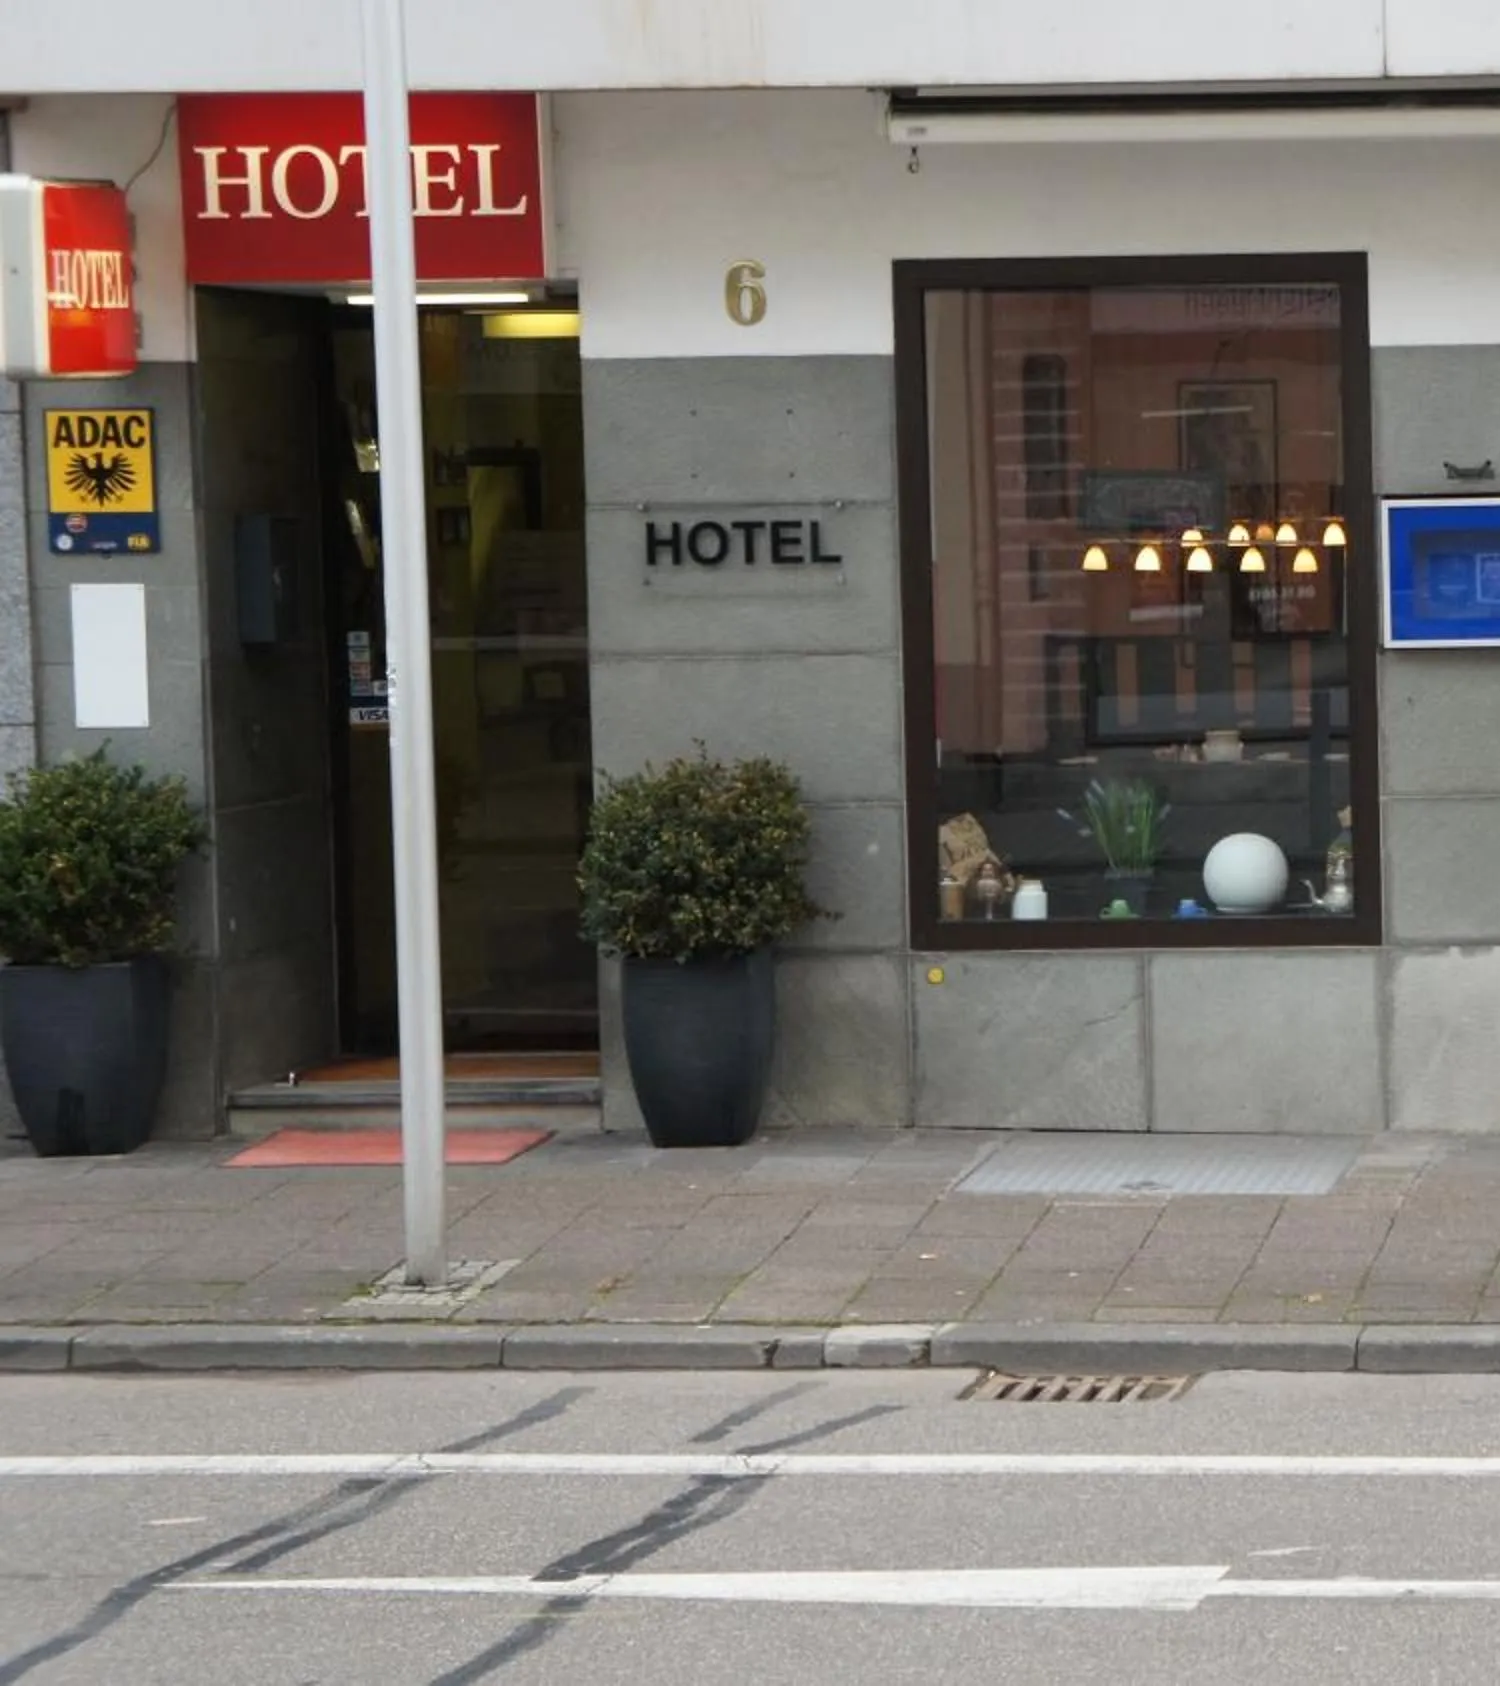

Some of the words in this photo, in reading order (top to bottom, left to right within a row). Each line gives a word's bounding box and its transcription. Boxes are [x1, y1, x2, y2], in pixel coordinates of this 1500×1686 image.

[50, 248, 129, 310] HOTEL
[724, 259, 767, 327] 6
[53, 415, 146, 449] ADAC
[644, 519, 843, 567] HOTEL
[358, 709, 390, 721] VISA
